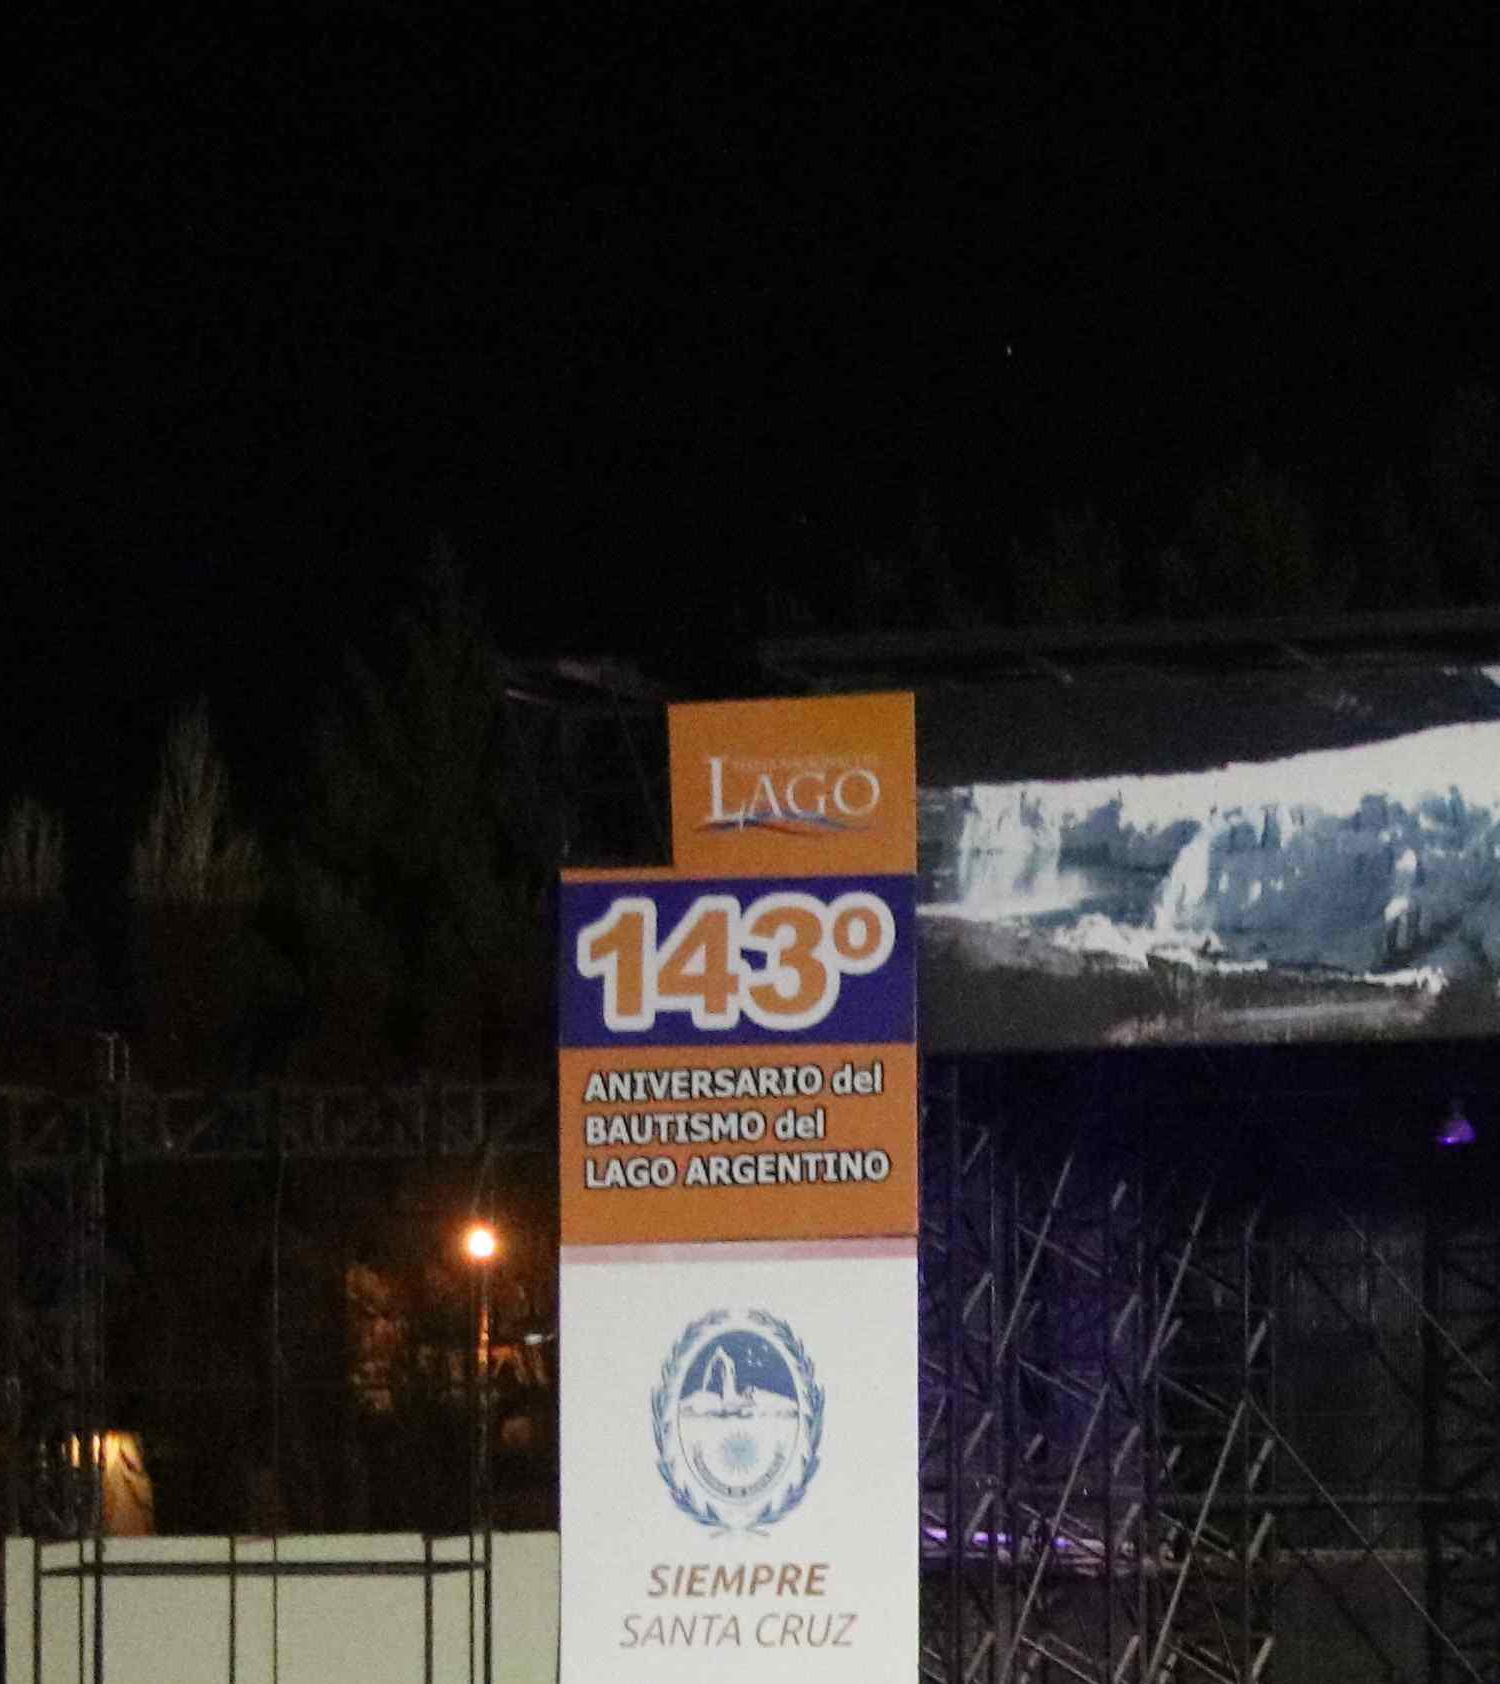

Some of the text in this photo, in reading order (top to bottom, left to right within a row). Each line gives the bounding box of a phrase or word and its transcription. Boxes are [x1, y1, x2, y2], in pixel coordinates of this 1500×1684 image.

[706, 756, 881, 828] LAGO
[583, 1060, 885, 1103] ANIVERSARIO del
[585, 1107, 826, 1146] BAUTISMO del
[585, 1149, 891, 1189] LAGO ARGENTINO
[648, 1562, 830, 1598] SIEMPRE
[619, 1612, 859, 1650] SANTA CRUZ
